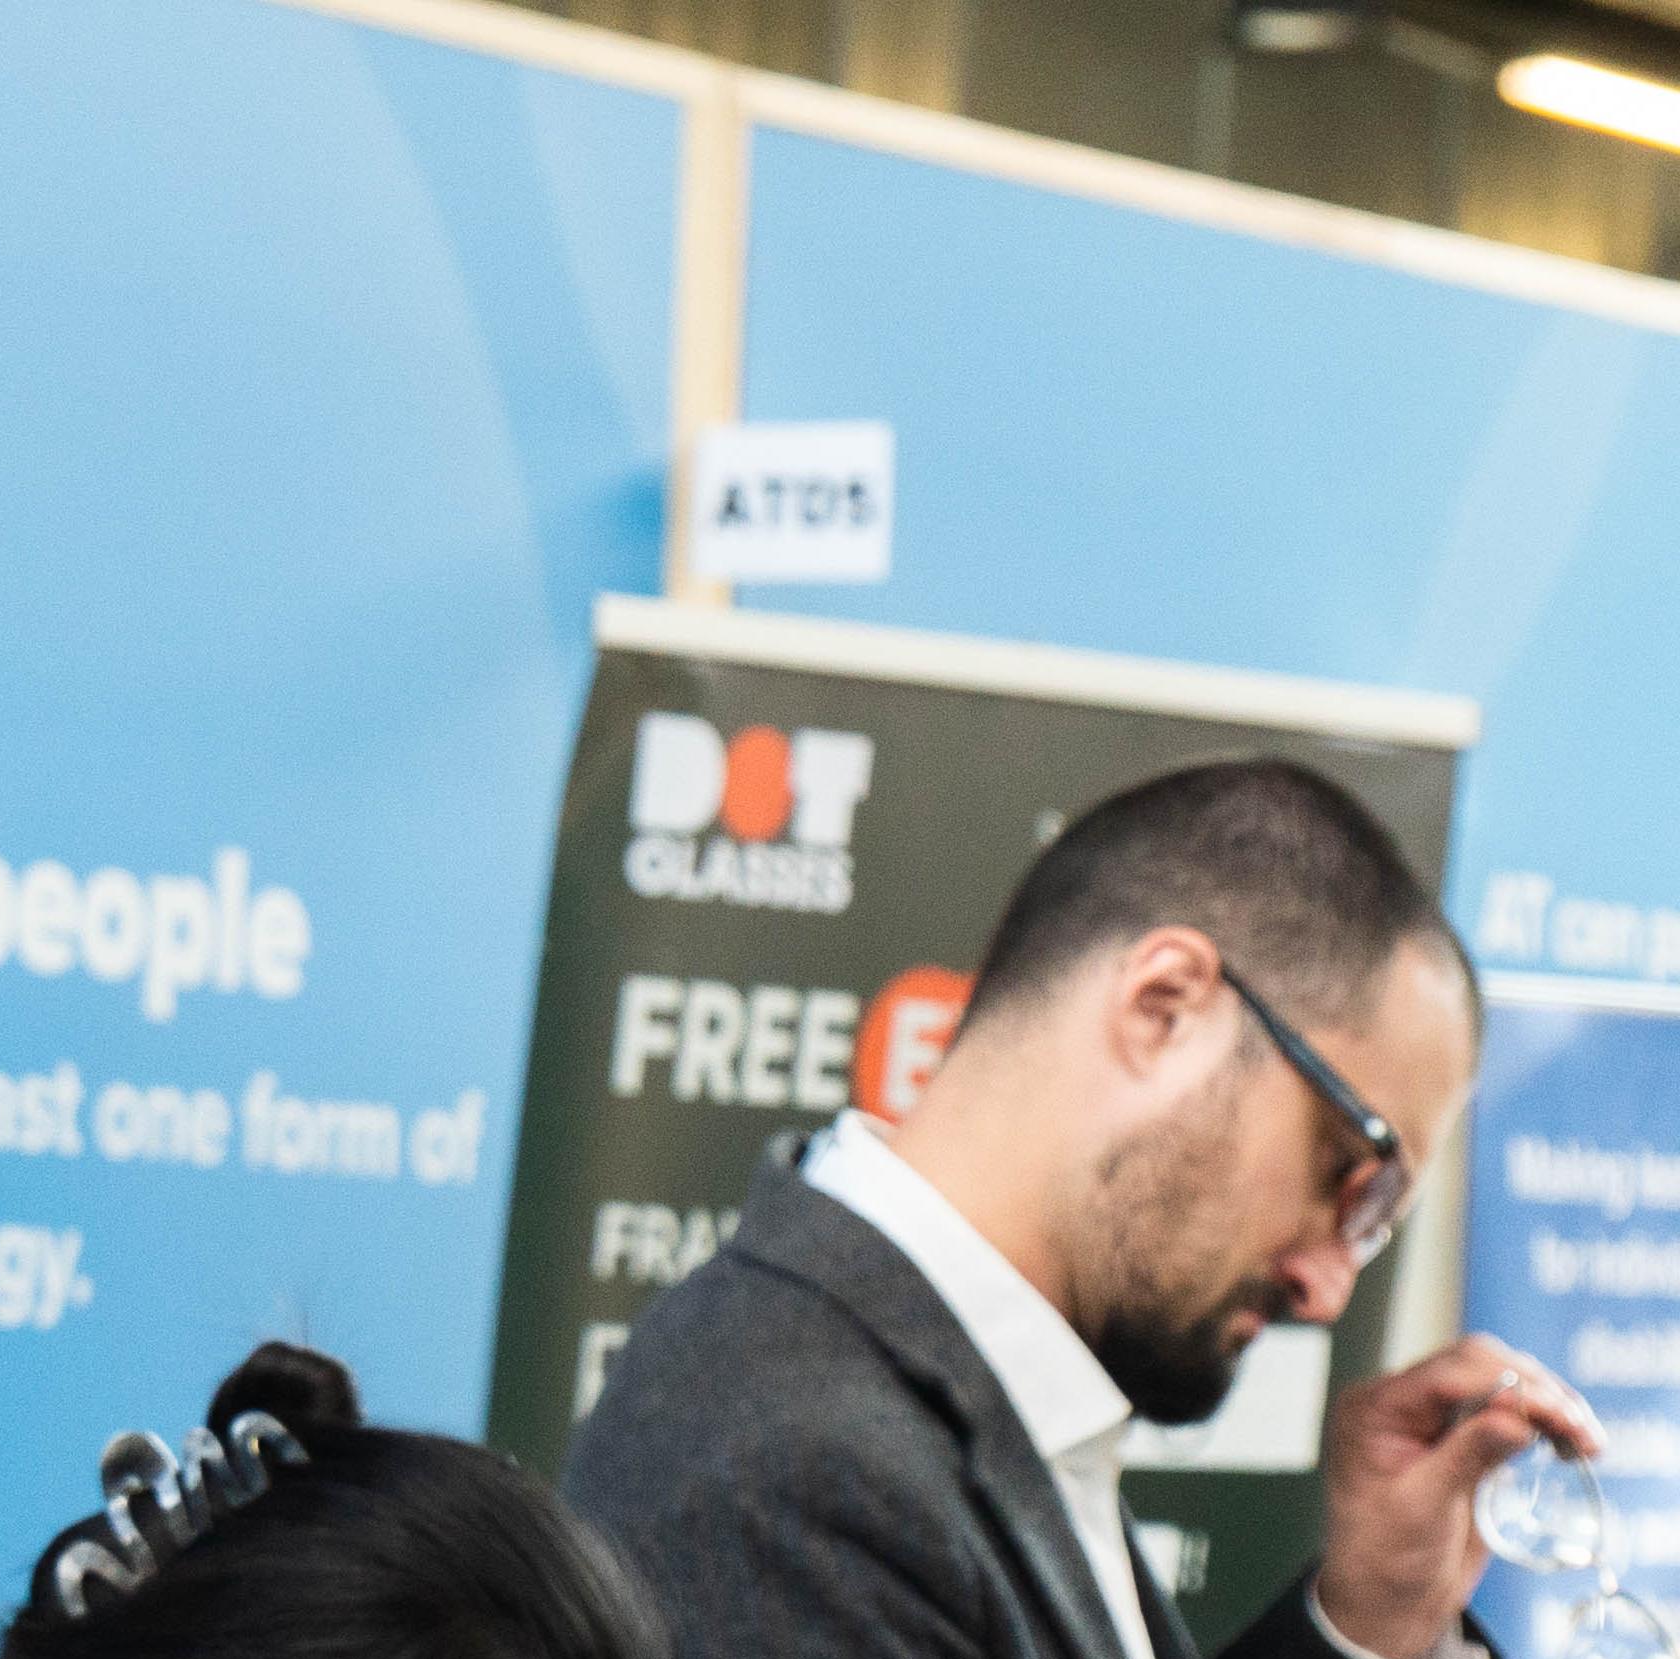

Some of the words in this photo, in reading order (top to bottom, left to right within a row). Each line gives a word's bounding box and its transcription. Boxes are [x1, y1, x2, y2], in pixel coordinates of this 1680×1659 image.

[716, 472, 875, 532] ATOS
[623, 833, 855, 915] GLASSES
[609, 973, 861, 1110] FREE
[95, 1083, 228, 1169] one
[242, 1072, 402, 1183] form
[410, 1088, 486, 1186] of
[591, 1201, 741, 1285] FRA
